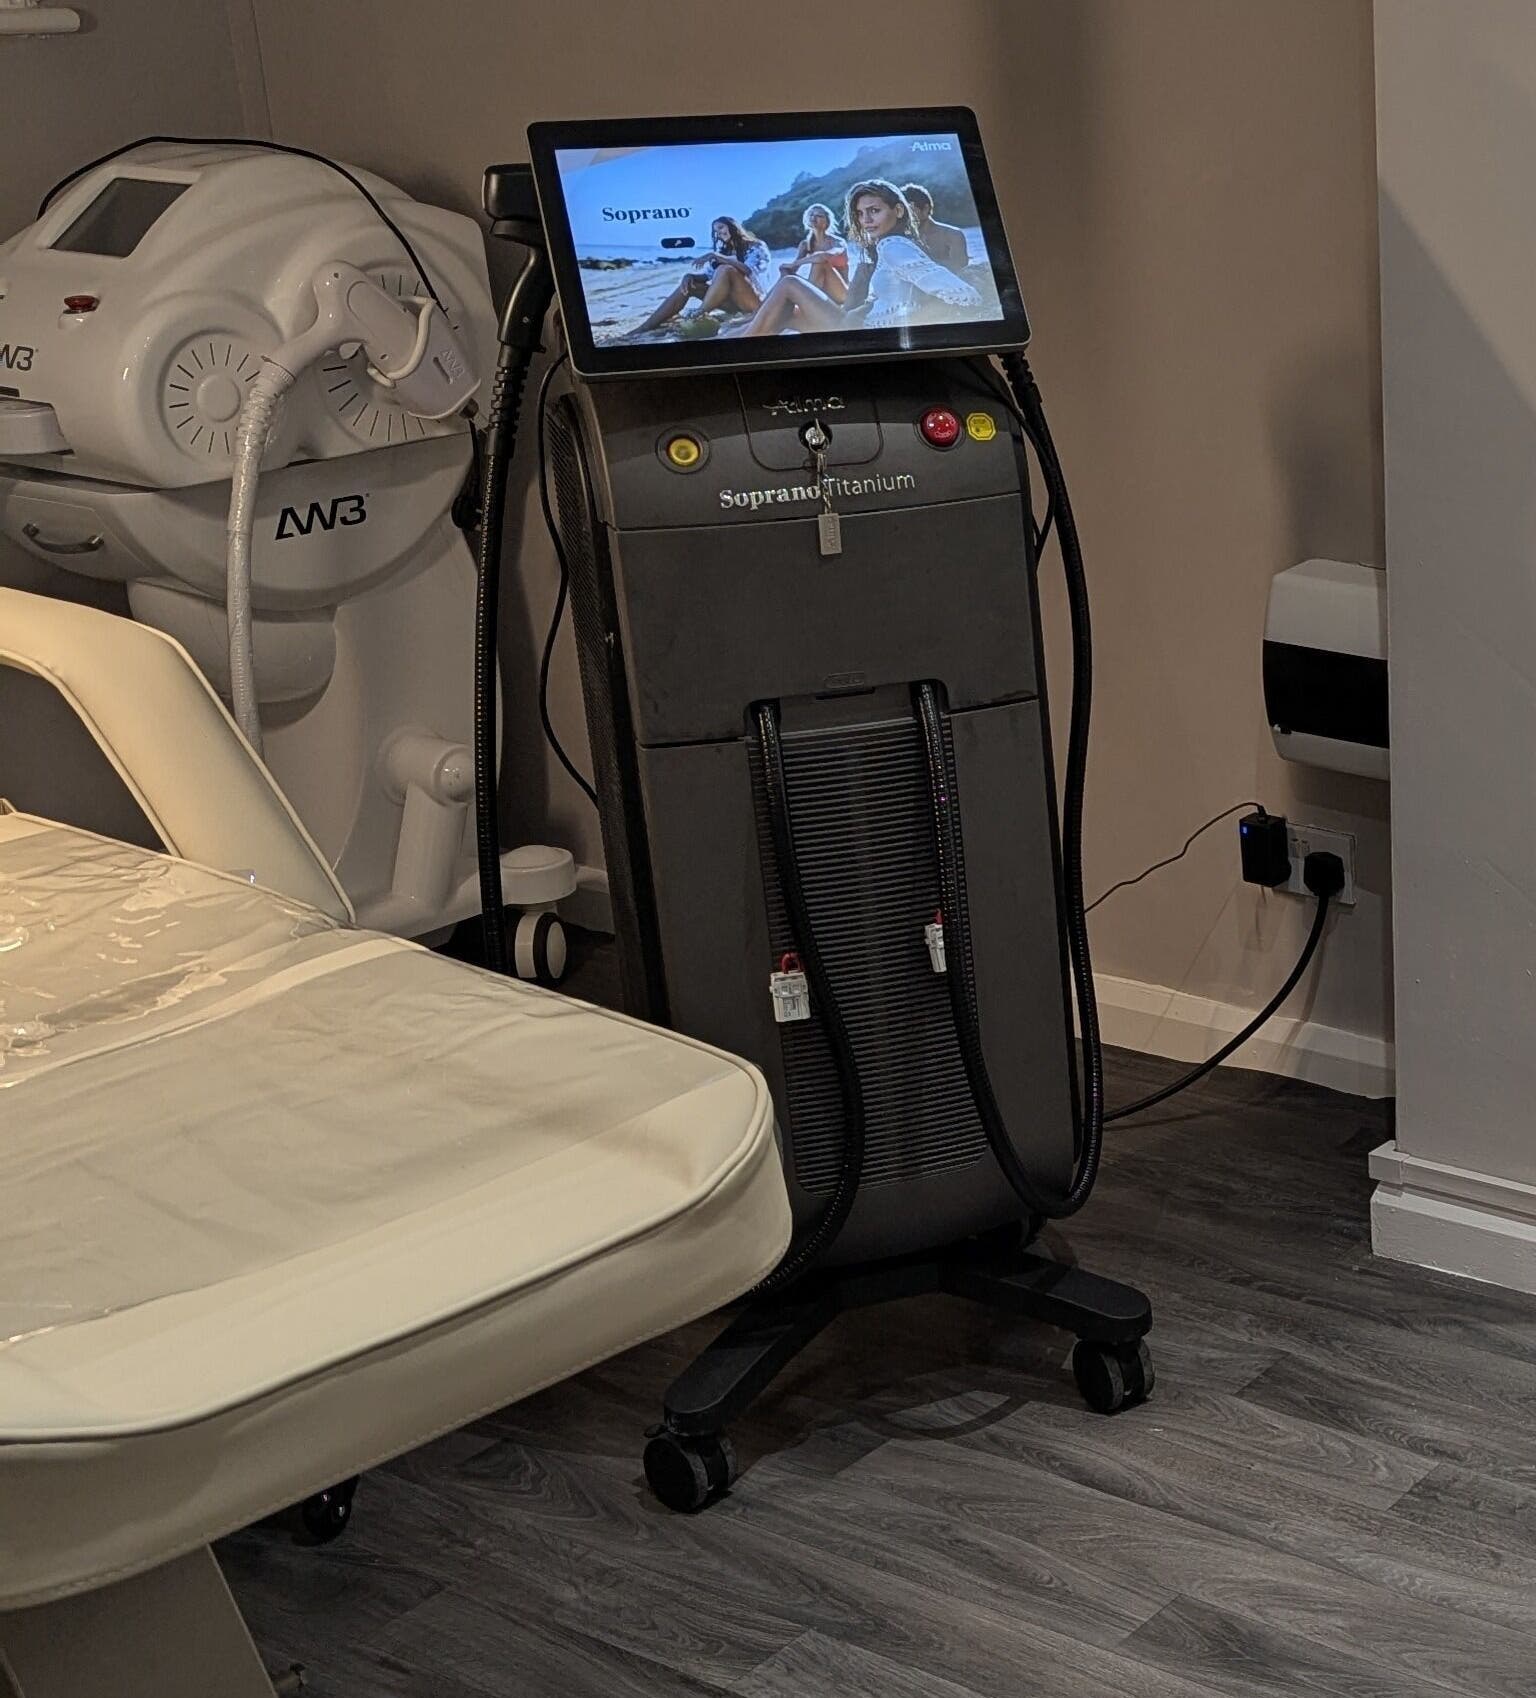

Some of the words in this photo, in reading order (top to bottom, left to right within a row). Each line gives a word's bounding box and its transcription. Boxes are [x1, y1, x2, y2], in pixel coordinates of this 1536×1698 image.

[910, 141, 952, 152] Alma
[602, 207, 690, 224] Soprano
[719, 485, 821, 511] Soprano
[822, 473, 916, 497] Titanium
